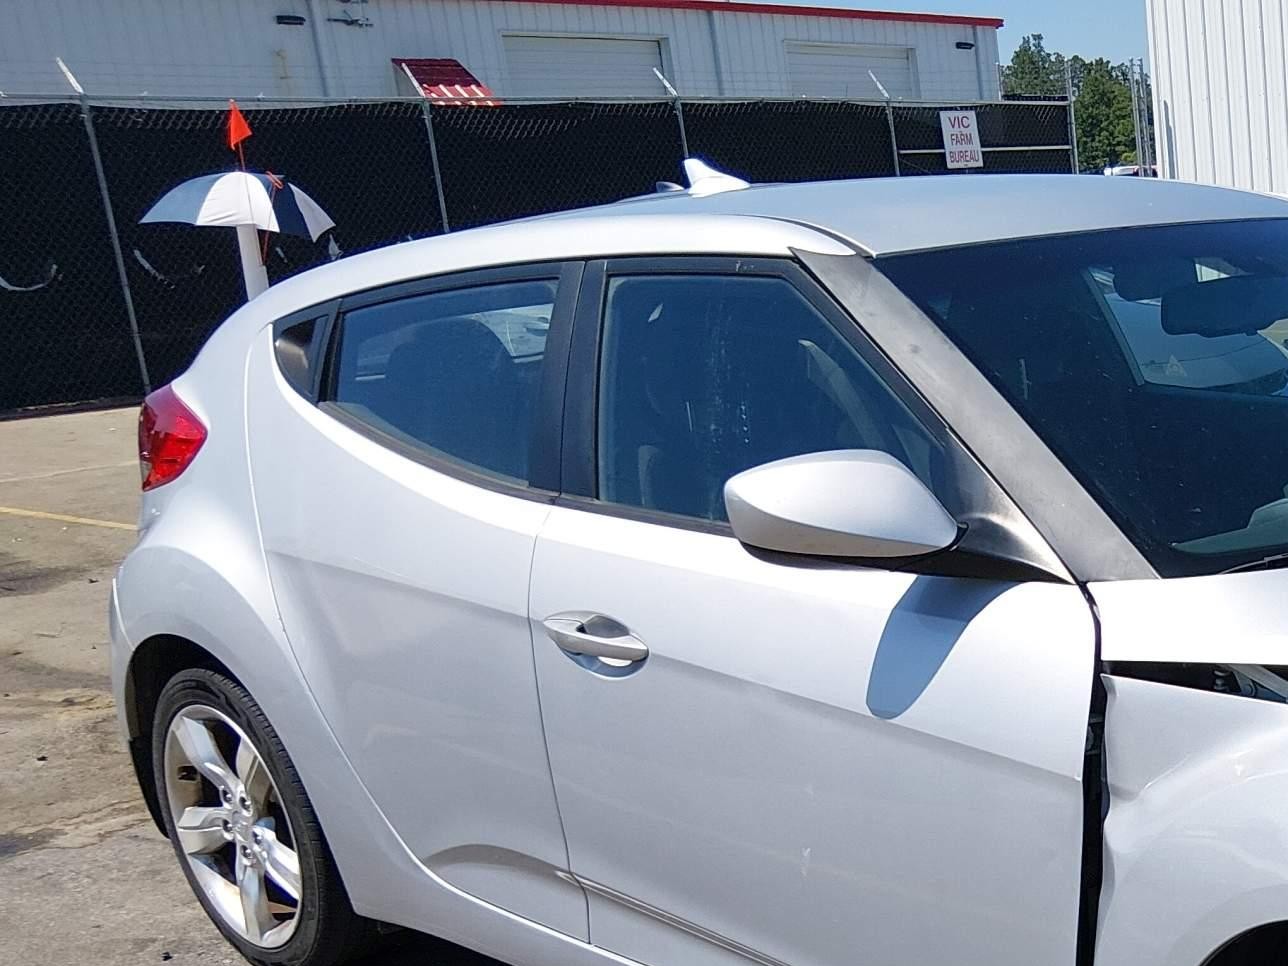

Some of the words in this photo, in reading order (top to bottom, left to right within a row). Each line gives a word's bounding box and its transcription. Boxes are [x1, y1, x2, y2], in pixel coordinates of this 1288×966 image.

[948, 115, 970, 129] VIC
[950, 132, 974, 146] FARM
[949, 149, 980, 163] BUREAU
